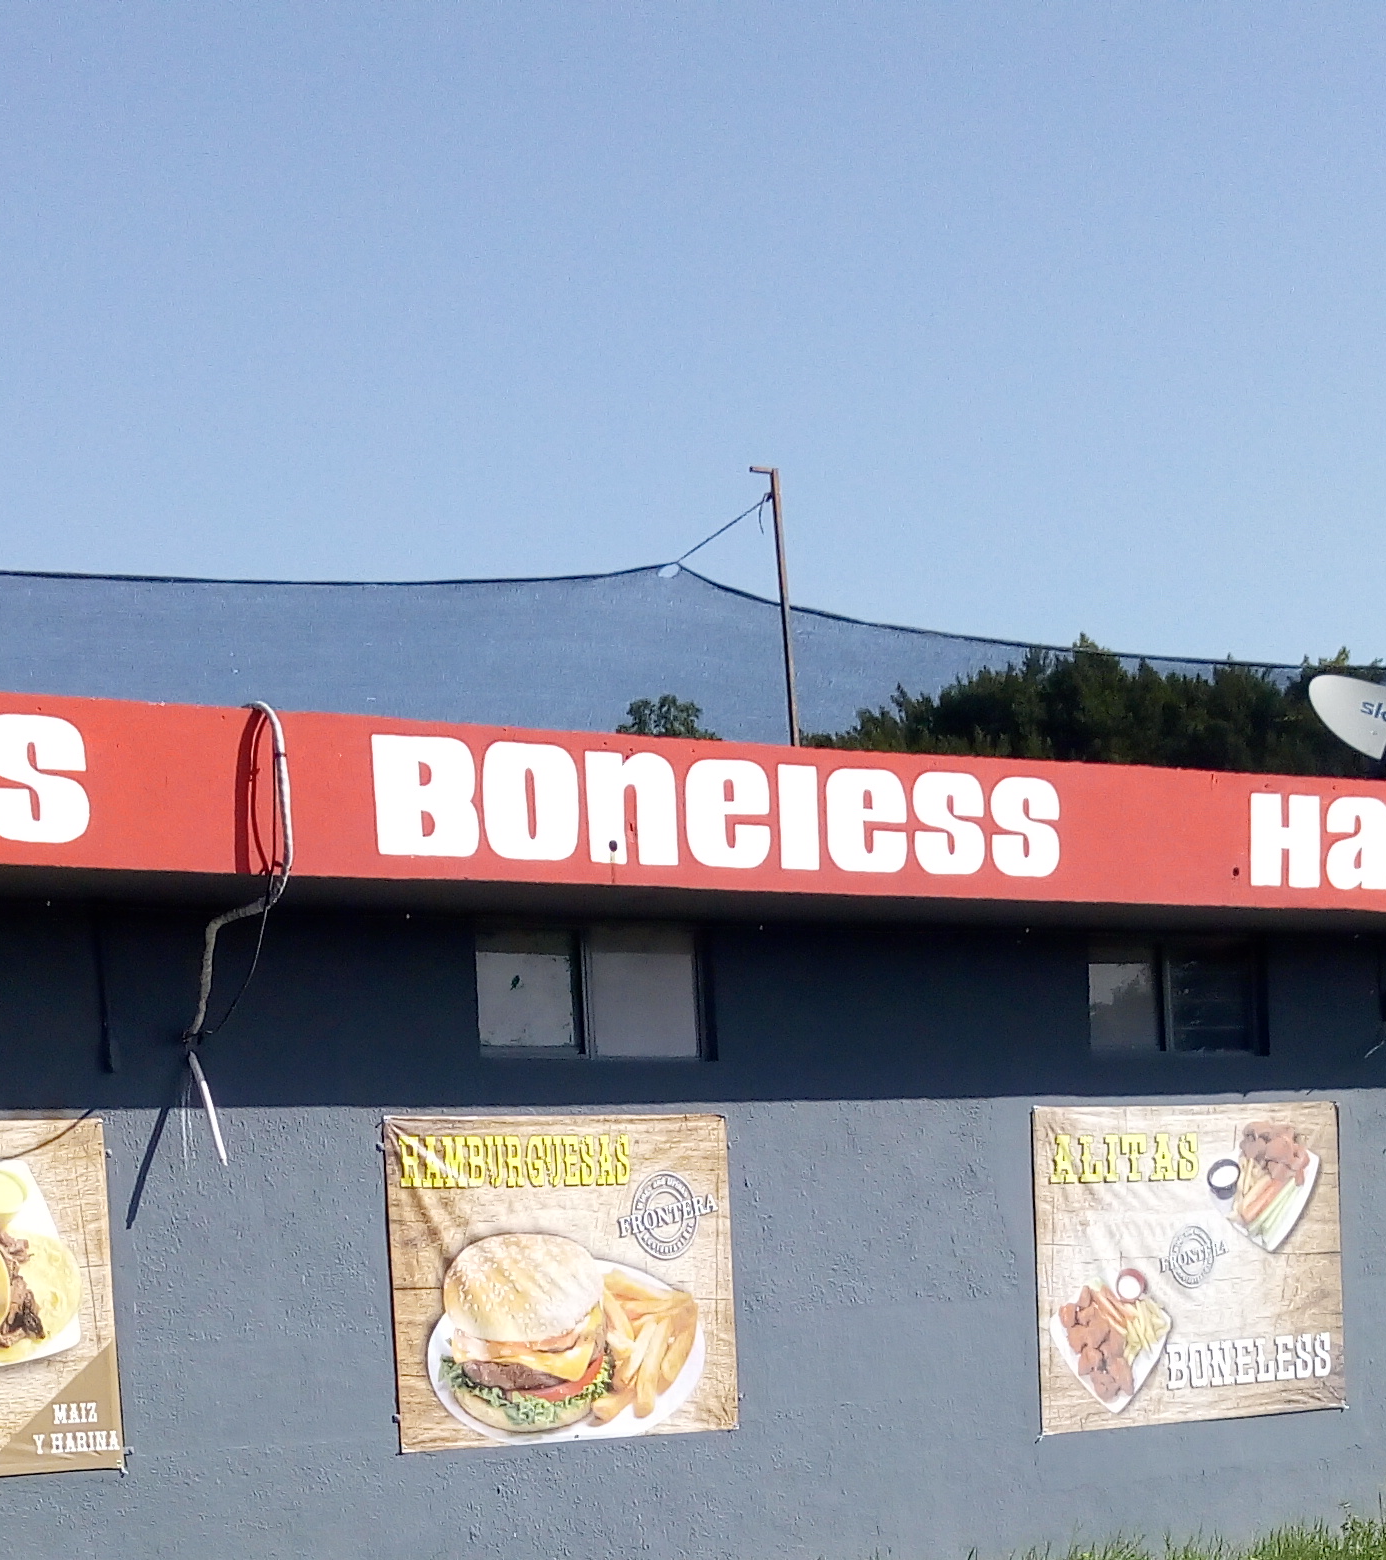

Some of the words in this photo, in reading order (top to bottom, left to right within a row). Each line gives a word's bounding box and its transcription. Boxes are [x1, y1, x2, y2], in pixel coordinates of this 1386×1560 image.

[370, 734, 1060, 877] Boneless
[399, 1134, 631, 1188] HAMBURGUESAS
[1050, 1132, 1200, 1184] ALITAS
[617, 1193, 719, 1239] FRONTERA
[1166, 1332, 1332, 1390] BONELESS
[53, 1402, 98, 1425] MAIZ
[33, 1433, 45, 1455] Y
